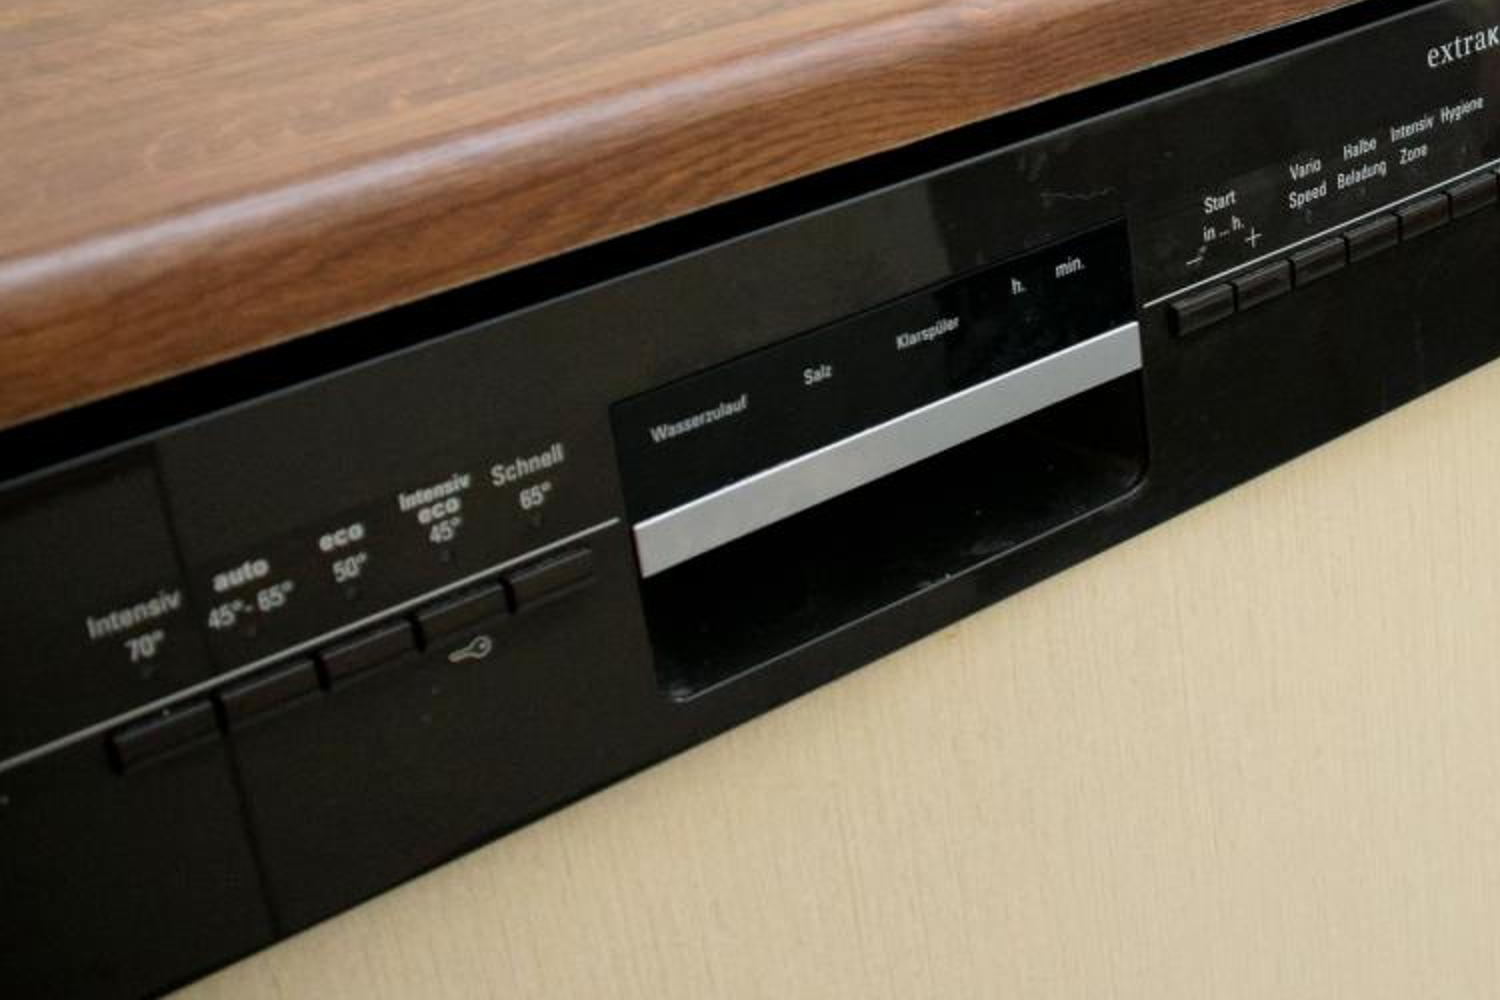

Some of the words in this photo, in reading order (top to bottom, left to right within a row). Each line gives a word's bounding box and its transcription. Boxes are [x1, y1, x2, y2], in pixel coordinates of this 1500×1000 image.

[1440, 97, 1484, 124] Hygiene
[1390, 116, 1434, 142] Intensiv
[1343, 138, 1377, 161] Halbe
[1400, 144, 1428, 165] Zone
[1289, 158, 1322, 181] Vario
[1337, 161, 1387, 190] Beladung
[1203, 190, 1236, 214] Start
[1289, 179, 1327, 209] Speed
[1203, 226, 1216, 242] in
[896, 316, 960, 351] Klarspüler
[803, 364, 833, 386] Salz
[650, 395, 748, 444] Wasserzulauf
[490, 442, 565, 487] Schnell
[398, 472, 471, 513] Intensiv
[417, 497, 461, 525] eco
[318, 523, 365, 553] eco
[212, 558, 270, 593] auto
[86, 588, 182, 641] Intensiv
